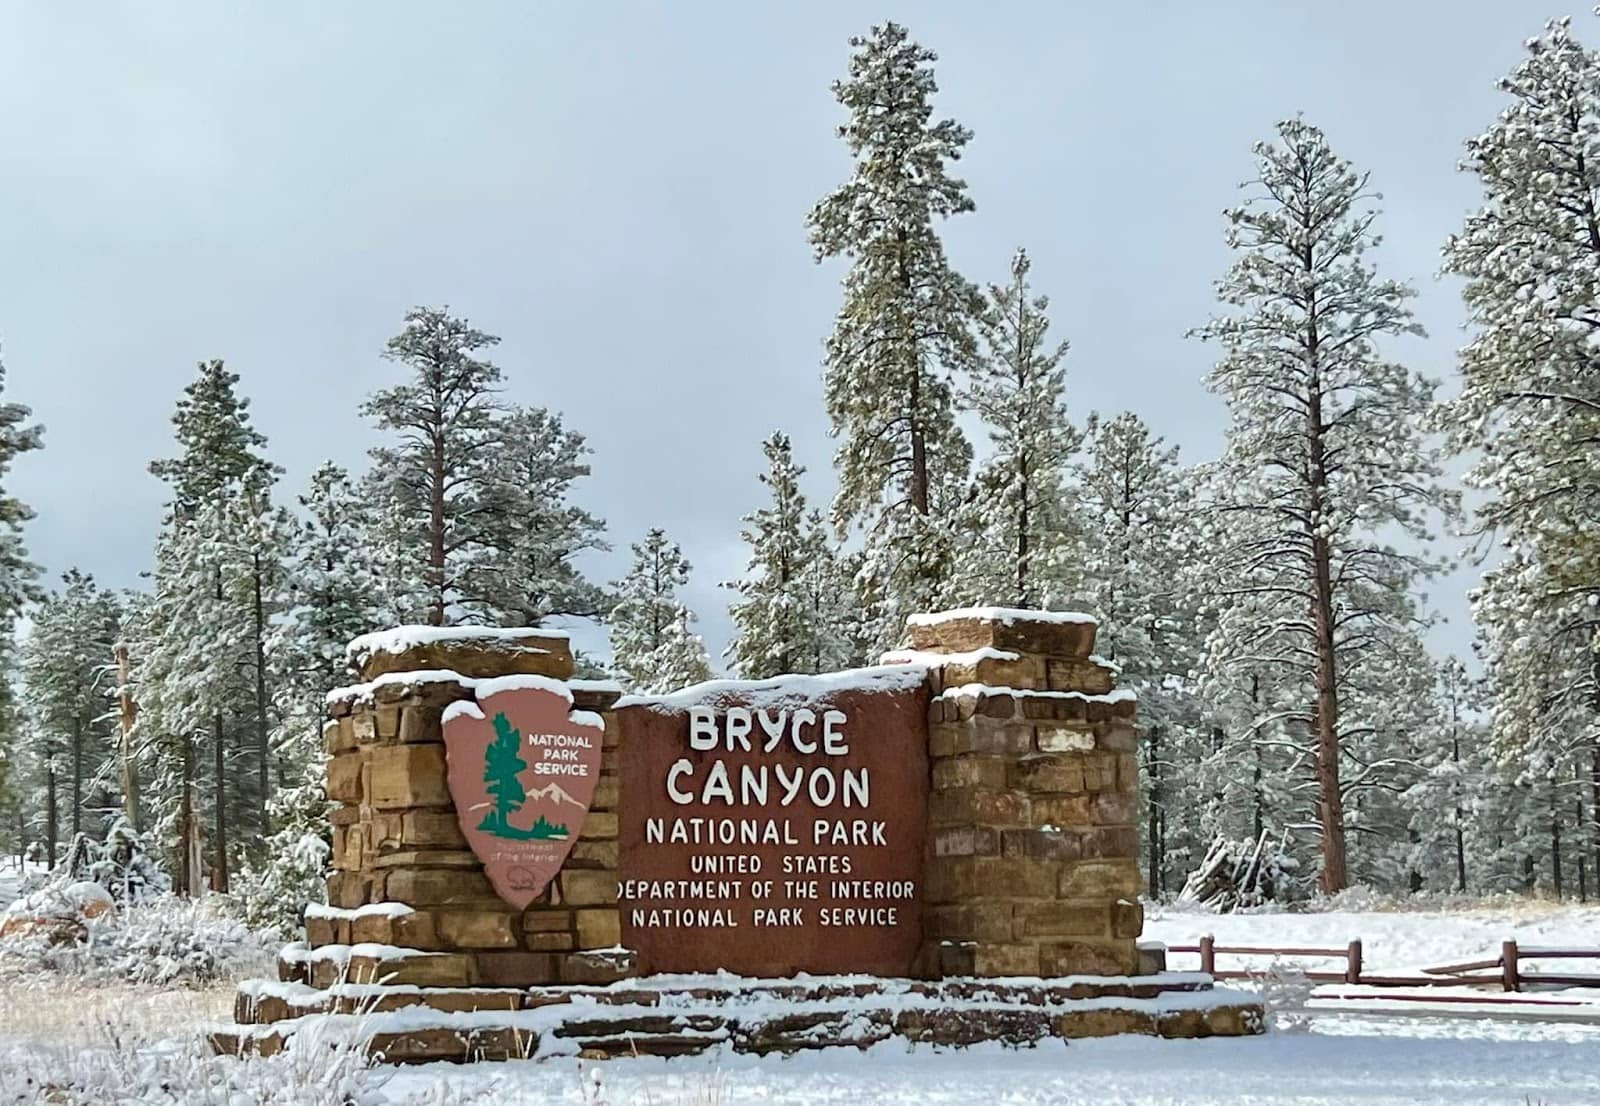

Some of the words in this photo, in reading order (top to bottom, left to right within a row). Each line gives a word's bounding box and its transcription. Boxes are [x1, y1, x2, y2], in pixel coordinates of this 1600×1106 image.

[689, 706, 849, 755] BRYCE
[528, 734, 593, 748] NATIONAL
[543, 748, 579, 760] PARK
[534, 762, 588, 776] SERVICE
[667, 759, 869, 808] CANYON
[646, 818, 799, 845] NATIONAL
[814, 819, 887, 846] PARK
[691, 855, 761, 874] UNITED
[783, 855, 852, 873] STATES
[752, 881, 773, 899] OF
[785, 881, 817, 899] THE
[832, 881, 914, 899] INTERIOR
[632, 908, 738, 927] NATIONAL
[755, 908, 803, 926] PARK
[820, 908, 897, 926] SERVICE
